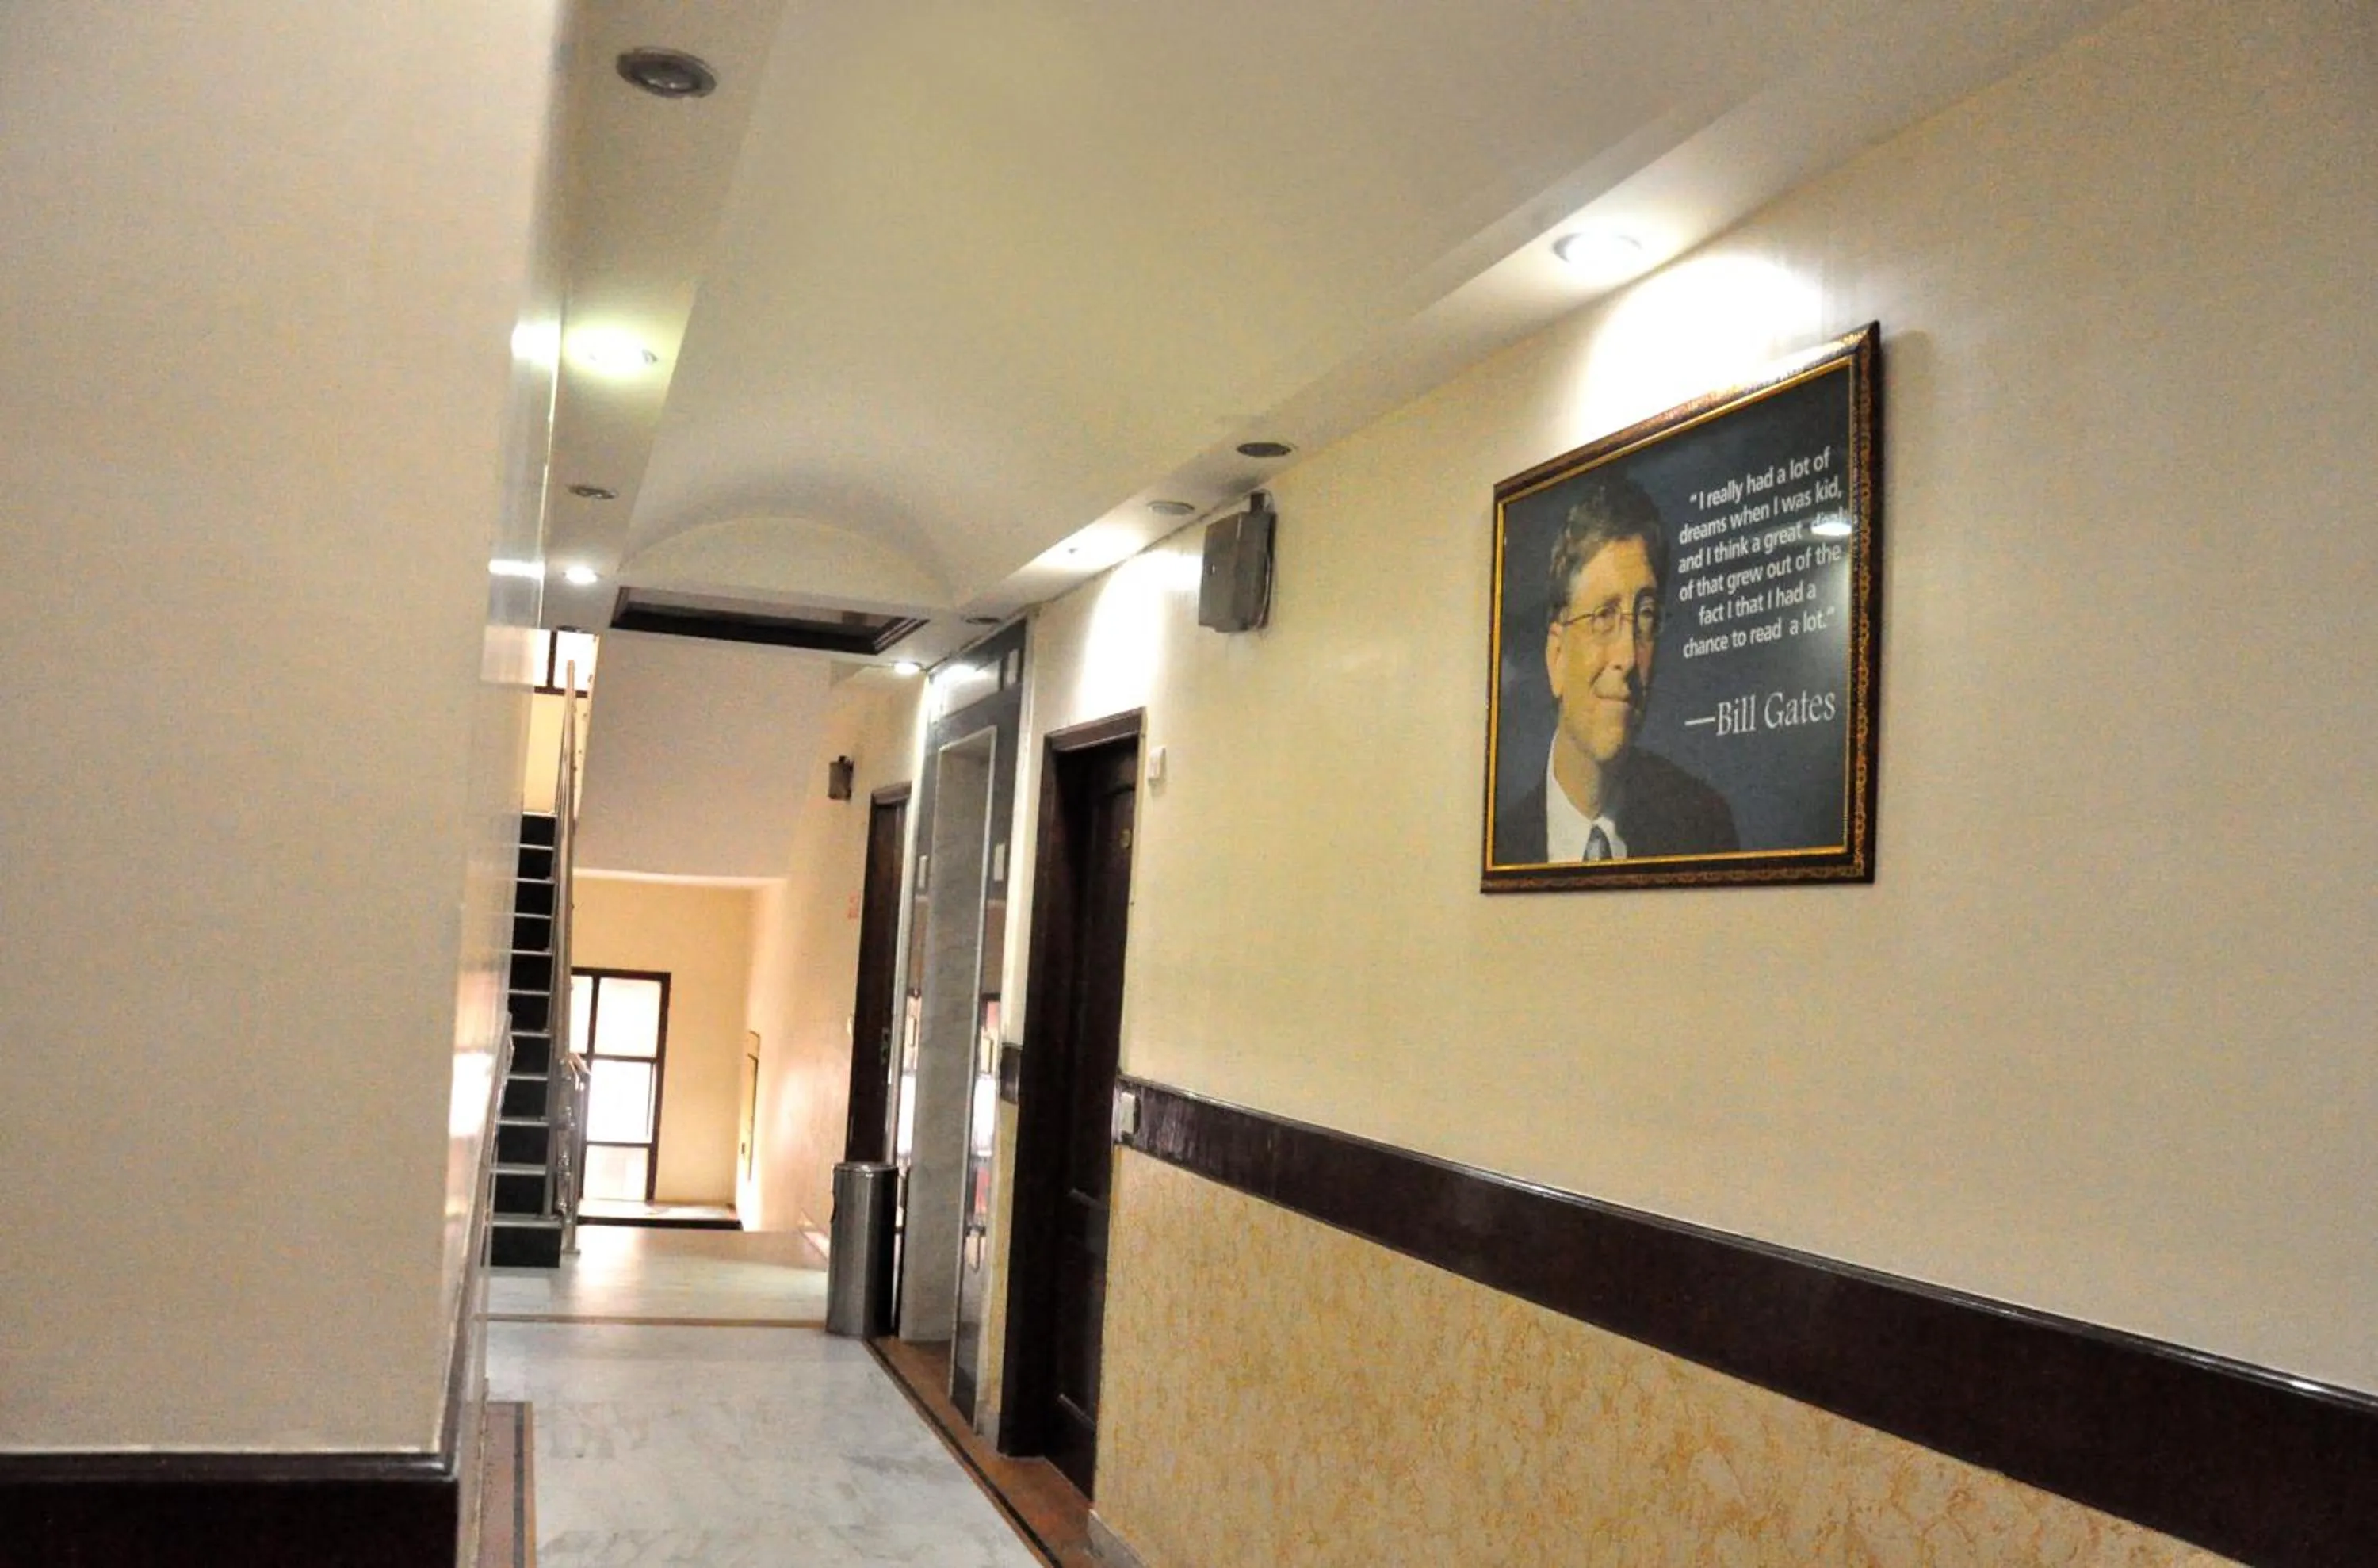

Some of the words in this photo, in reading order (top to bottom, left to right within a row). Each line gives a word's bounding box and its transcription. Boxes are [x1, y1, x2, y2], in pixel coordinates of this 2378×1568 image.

[1707, 480, 1743, 507] really
[1747, 466, 1773, 494] had
[1777, 468, 1785, 484] a
[1790, 457, 1810, 480] lot
[1814, 446, 1830, 472] of
[1679, 517, 1727, 545] dreams
[1730, 503, 1769, 530] when
[1774, 495, 1778, 515] I
[1781, 489, 1811, 512] was
[1678, 548, 1703, 573] and
[1707, 547, 1711, 565] I
[1714, 536, 1749, 564] think
[1751, 537, 1761, 553] a
[1764, 522, 1803, 554] great
[1680, 580, 1694, 601] of
[1697, 578, 1723, 596] that
[1727, 564, 1764, 595] grew
[1767, 555, 1792, 579] out
[1795, 547, 1812, 570] of
[1815, 541, 1841, 565] the
[1699, 603, 1723, 626] fact
[1727, 599, 1732, 619] I
[1735, 595, 1764, 617] that
[1768, 590, 1772, 609] I
[1776, 580, 1804, 608] had
[1806, 583, 1816, 599] a
[1683, 637, 1729, 659] chance
[1732, 629, 1747, 648] to
[1749, 618, 1782, 644] read
[1789, 619, 1799, 635] a
[1764, 690, 1836, 729] Gates
